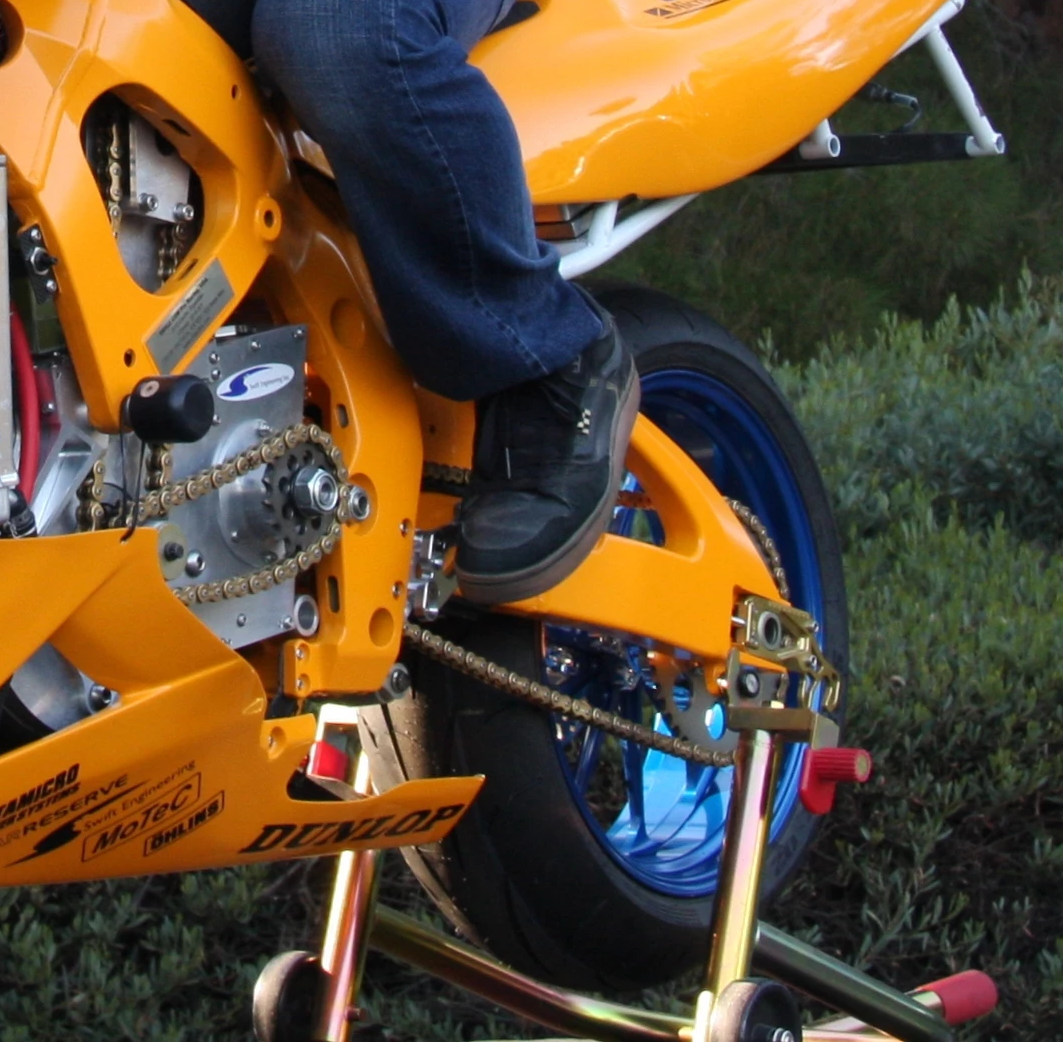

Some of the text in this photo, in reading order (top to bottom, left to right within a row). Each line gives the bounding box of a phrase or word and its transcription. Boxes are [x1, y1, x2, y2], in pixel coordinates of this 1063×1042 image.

[84, 760, 196, 832] Swift Engineering
[92, 784, 193, 853] MoTeC
[238, 804, 465, 853] DUNLOP
